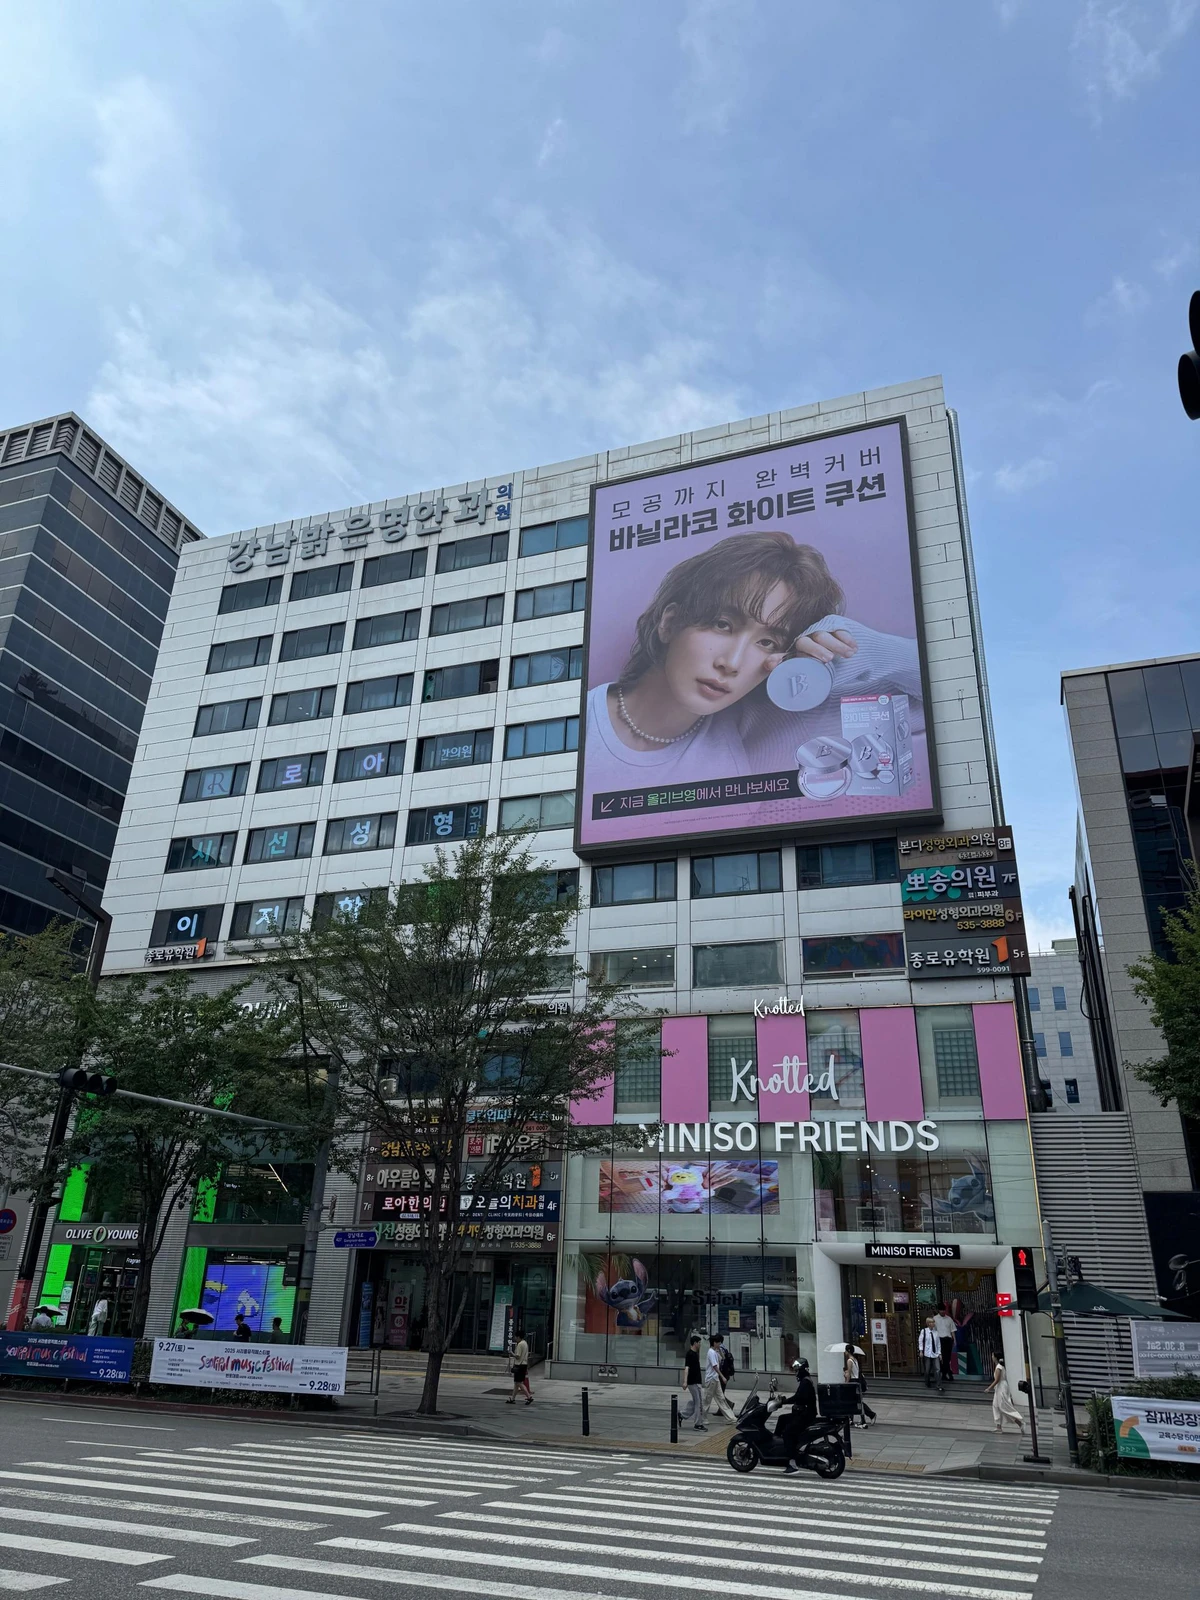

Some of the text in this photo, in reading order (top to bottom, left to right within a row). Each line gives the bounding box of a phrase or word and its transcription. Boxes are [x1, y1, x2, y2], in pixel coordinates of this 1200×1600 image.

[611, 479, 726, 521] 모공까지
[609, 473, 887, 552] 바닐라코 화이트 쿠션
[620, 778, 790, 810] 지금 올리브영에서 만나보세요
[998, 839, 1012, 849] 8F
[905, 865, 1017, 893] 뽀송의원 7F
[956, 919, 1006, 930] 535-3888
[144, 945, 195, 963] 종로유학원
[909, 947, 991, 969] 종로유학원
[1013, 949, 1025, 958] 5F
[977, 965, 1010, 974] 599-0091
[754, 995, 805, 1018] Knotted
[730, 1054, 839, 1102] Knotted
[774, 1120, 940, 1152] FRIENDS
[366, 1174, 374, 1182] 8F
[363, 1202, 372, 1210] 7F
[547, 1201, 558, 1211] 4F
[65, 1228, 139, 1240] OLIVE YOUNG
[546, 1232, 557, 1241] 6F
[871, 1246, 954, 1257] MINISO FRIENDS
[231, 1357, 262, 1374] music
[261, 1355, 295, 1374] festival
[98, 1368, 127, 1379] 9.28(일)
[309, 1380, 341, 1392] 9.28(일)
[1144, 1410, 1200, 1427] 잠재성장
